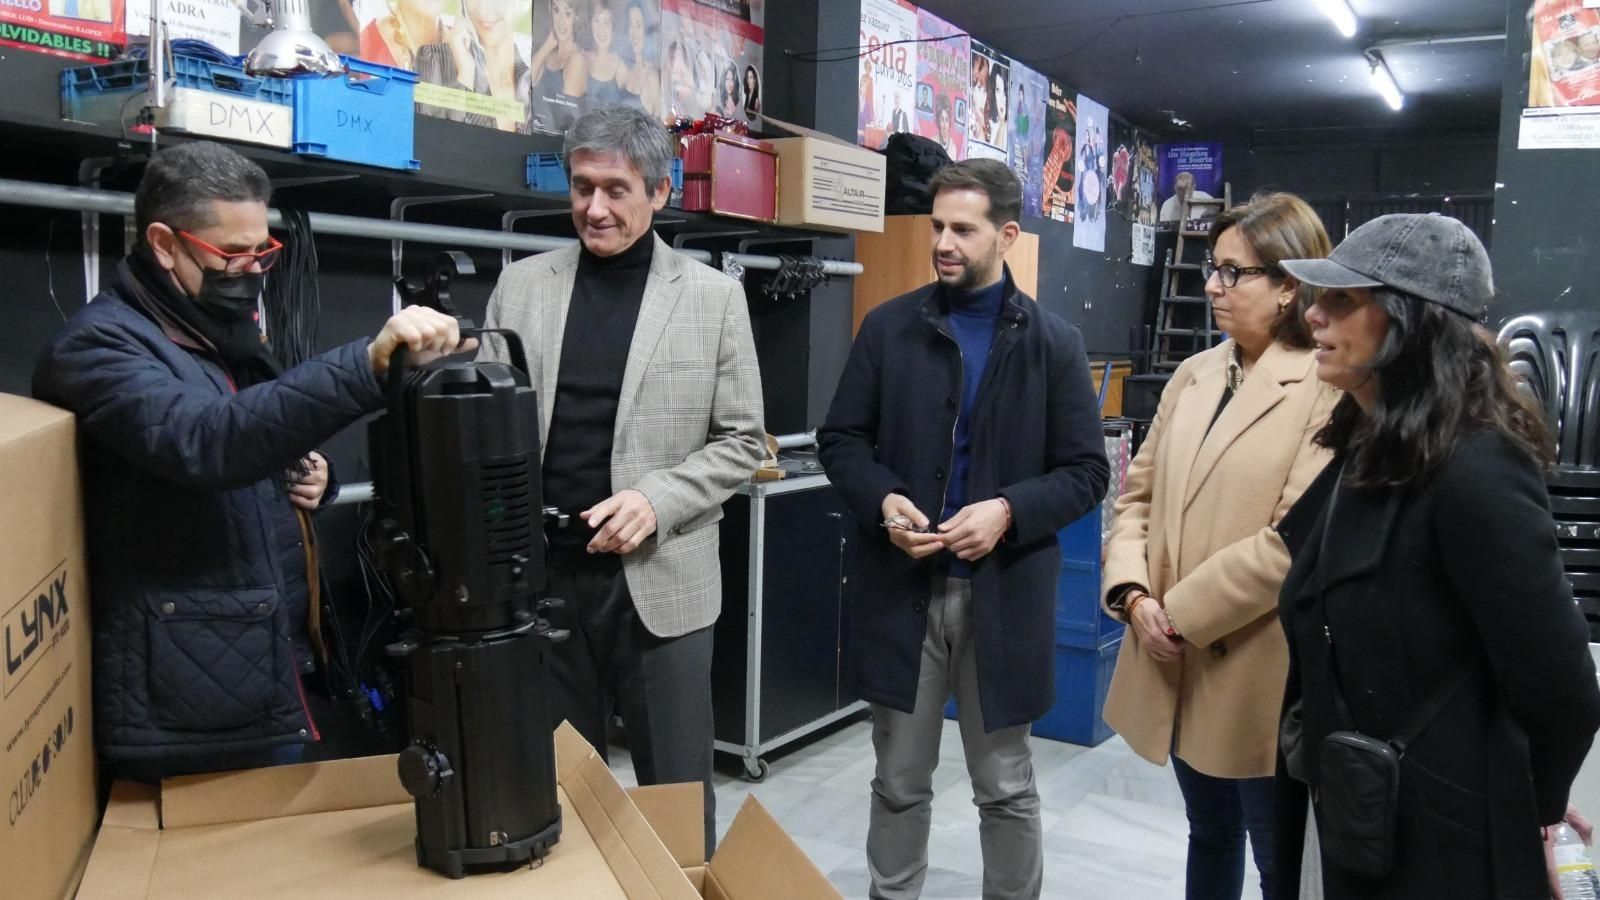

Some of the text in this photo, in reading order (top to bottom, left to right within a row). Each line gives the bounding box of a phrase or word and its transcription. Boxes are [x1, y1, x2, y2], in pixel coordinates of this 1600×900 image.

[167, 1, 206, 19] ADRA
[0, 23, 92, 54] LVIDABLES
[209, 101, 274, 138] DMX
[336, 109, 374, 134] DMX
[6, 570, 69, 676] LYNX
